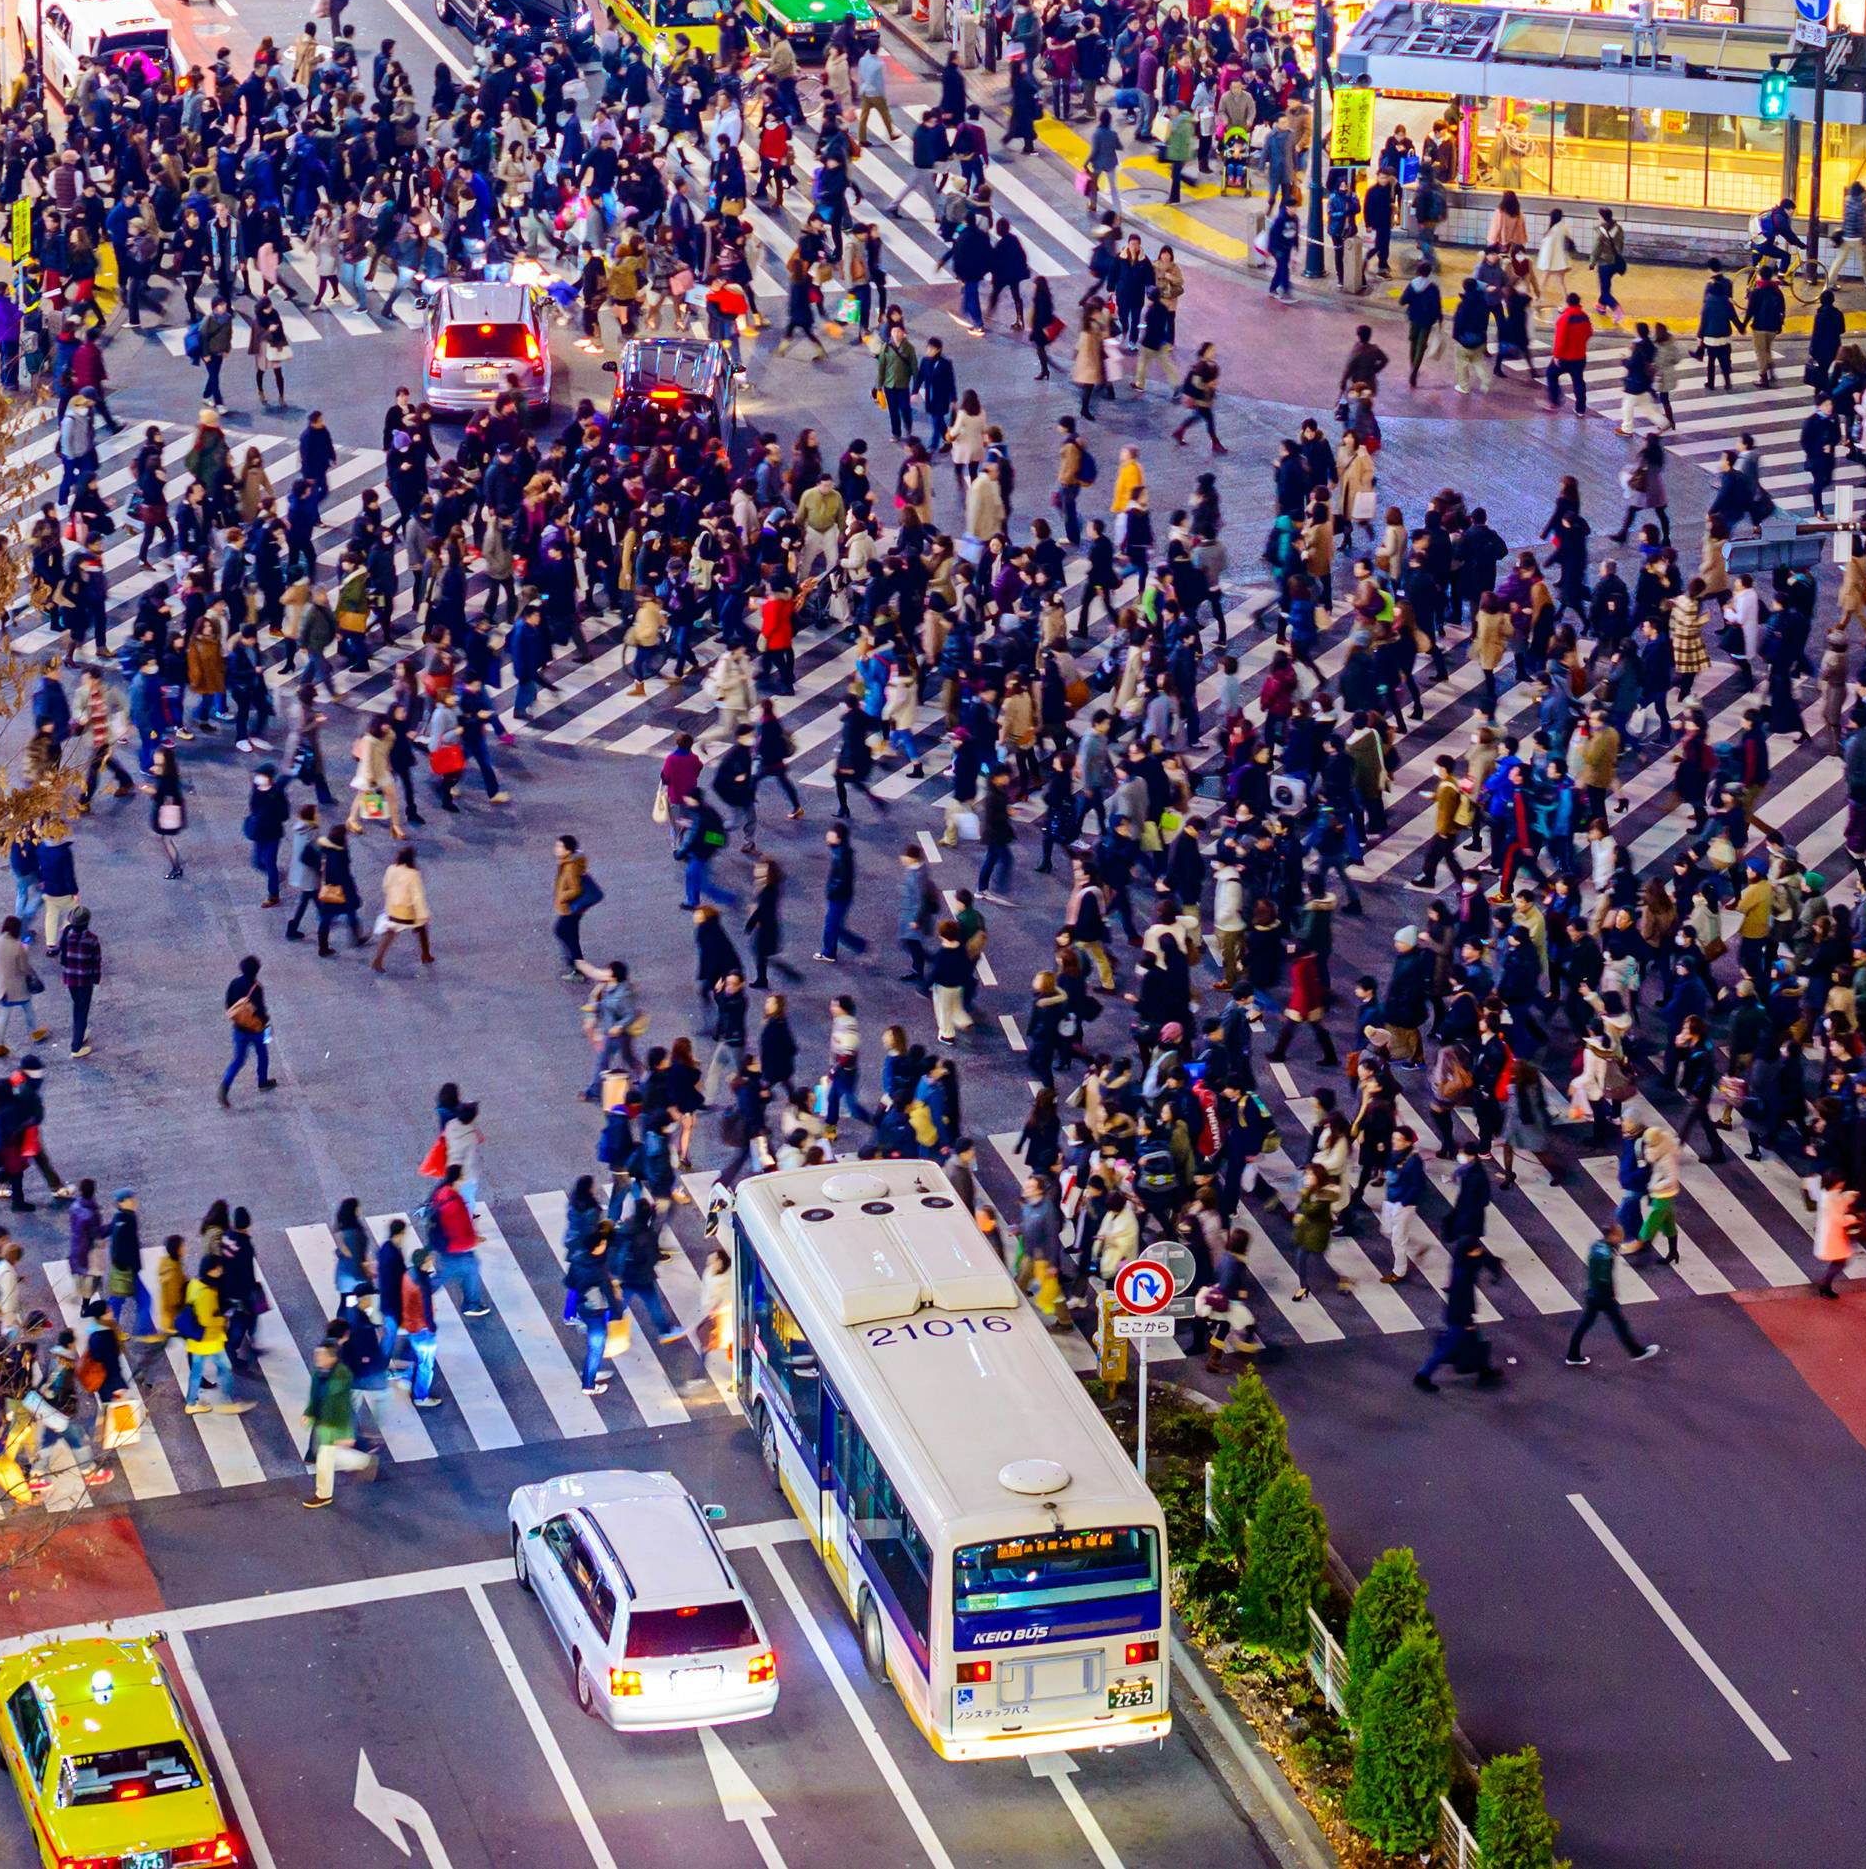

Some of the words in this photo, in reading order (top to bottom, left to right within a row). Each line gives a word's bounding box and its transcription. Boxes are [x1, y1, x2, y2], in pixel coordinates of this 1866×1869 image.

[867, 1314, 1013, 1347] 21016
[1119, 1321, 1169, 1334] ここから
[973, 1630, 1013, 1645] KEIO
[1014, 1625, 1050, 1642] BUS
[1140, 1633, 1159, 1642] 016
[1115, 1689, 1152, 1708] 22-52
[956, 1706, 1030, 1721] ノンステップバス
